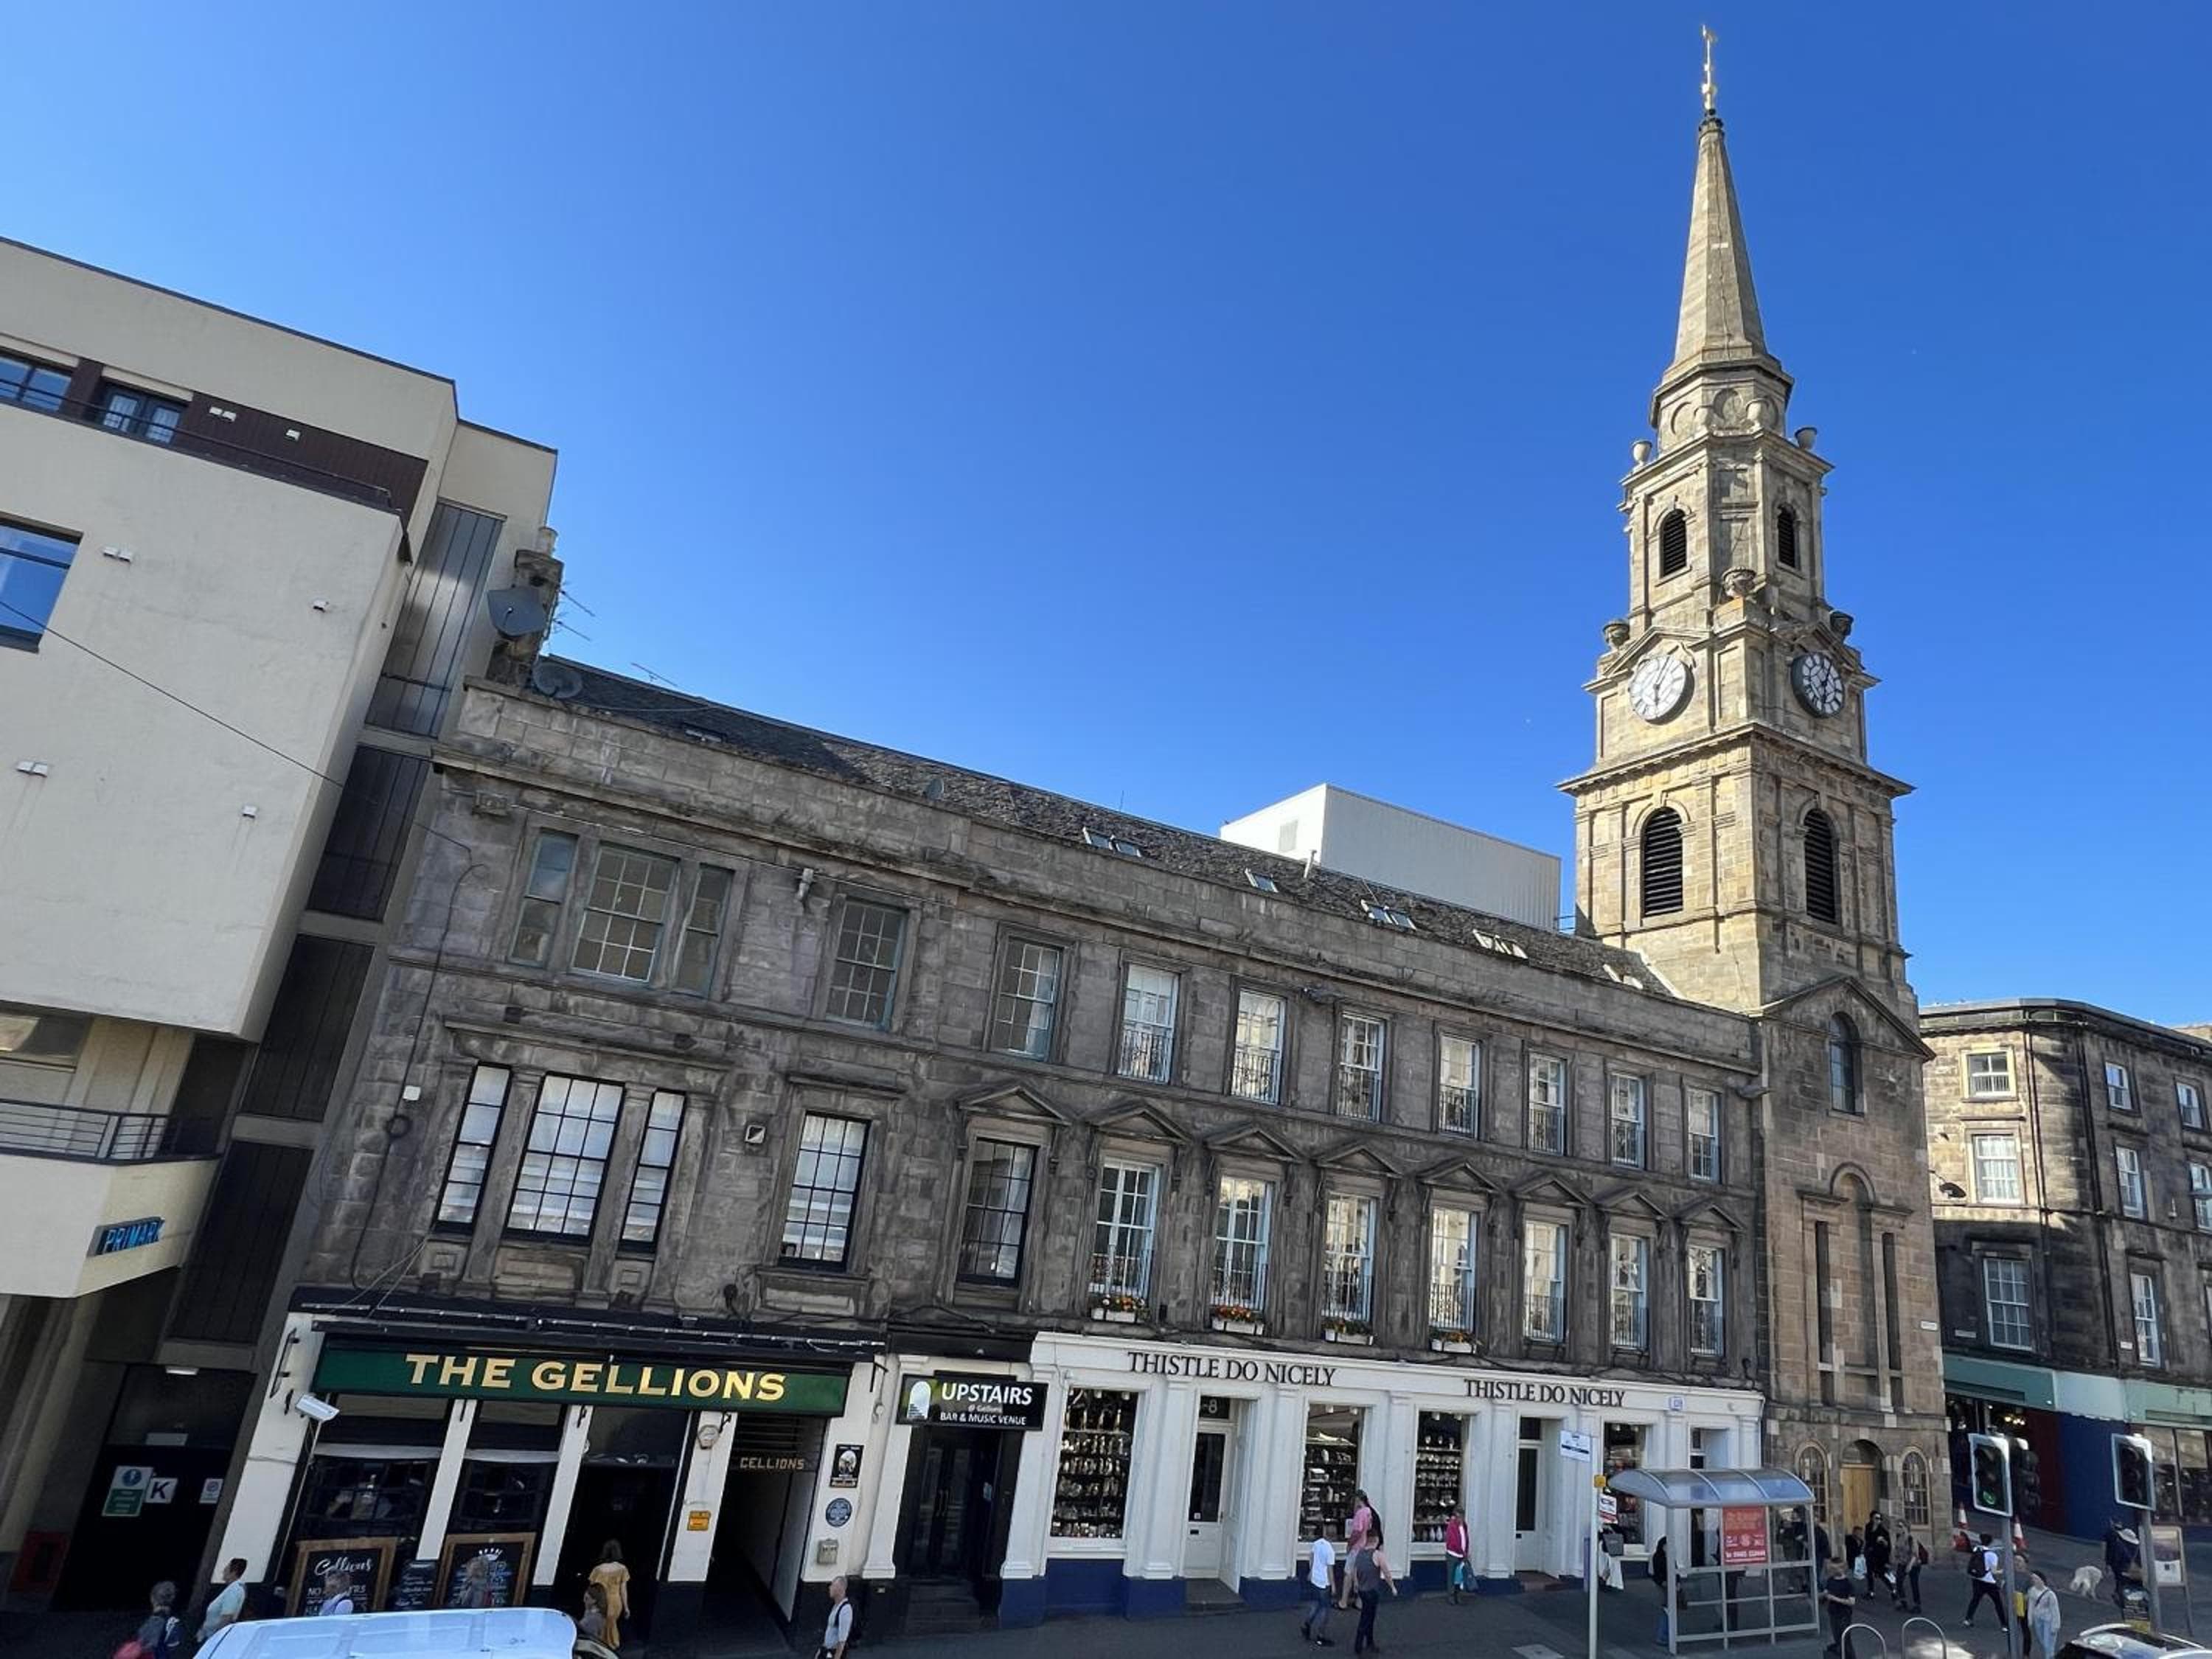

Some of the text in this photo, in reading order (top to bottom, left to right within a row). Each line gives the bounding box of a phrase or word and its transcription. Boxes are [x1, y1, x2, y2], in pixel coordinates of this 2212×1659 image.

[406, 1354, 787, 1401] THE GELLIONS
[1128, 1352, 1338, 1386] THISTLE DO NICELY
[942, 1382, 1033, 1405] UPSTAIRS
[1464, 1379, 1625, 1407] THISTLE DO NICELY
[940, 1412, 1027, 1425] BAR & MUSIC VENUE
[150, 1481, 170, 1499] K
